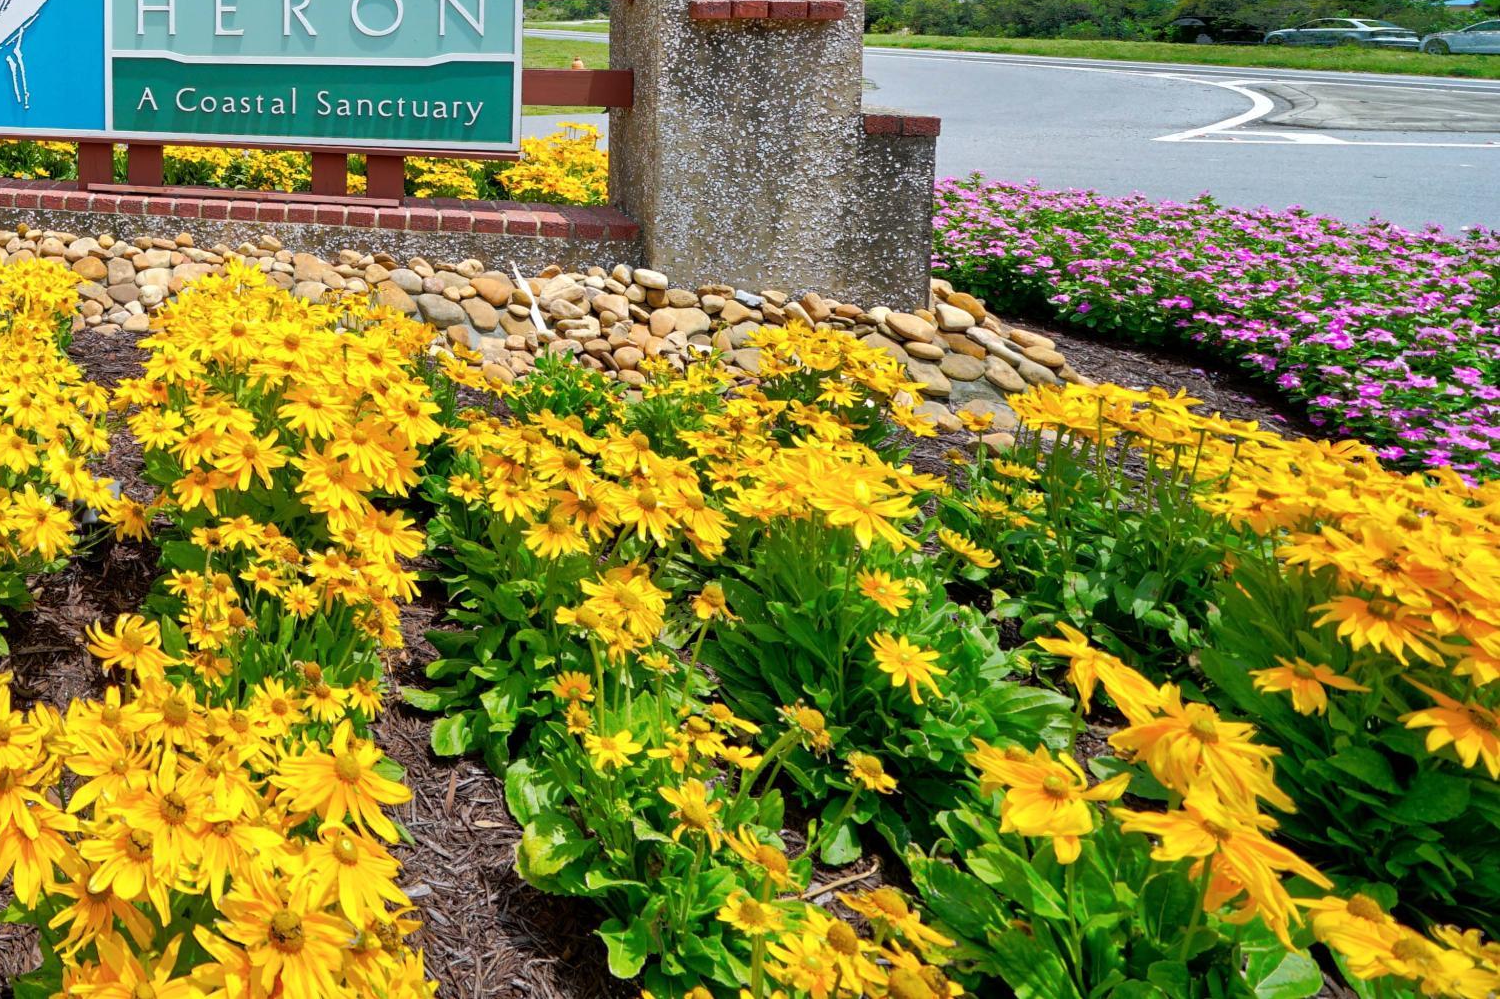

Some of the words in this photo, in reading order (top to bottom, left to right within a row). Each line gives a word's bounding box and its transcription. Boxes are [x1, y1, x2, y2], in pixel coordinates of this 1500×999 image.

[137, 87, 158, 111] A
[176, 87, 298, 117] Coastal
[317, 90, 484, 127] Sanctuary
